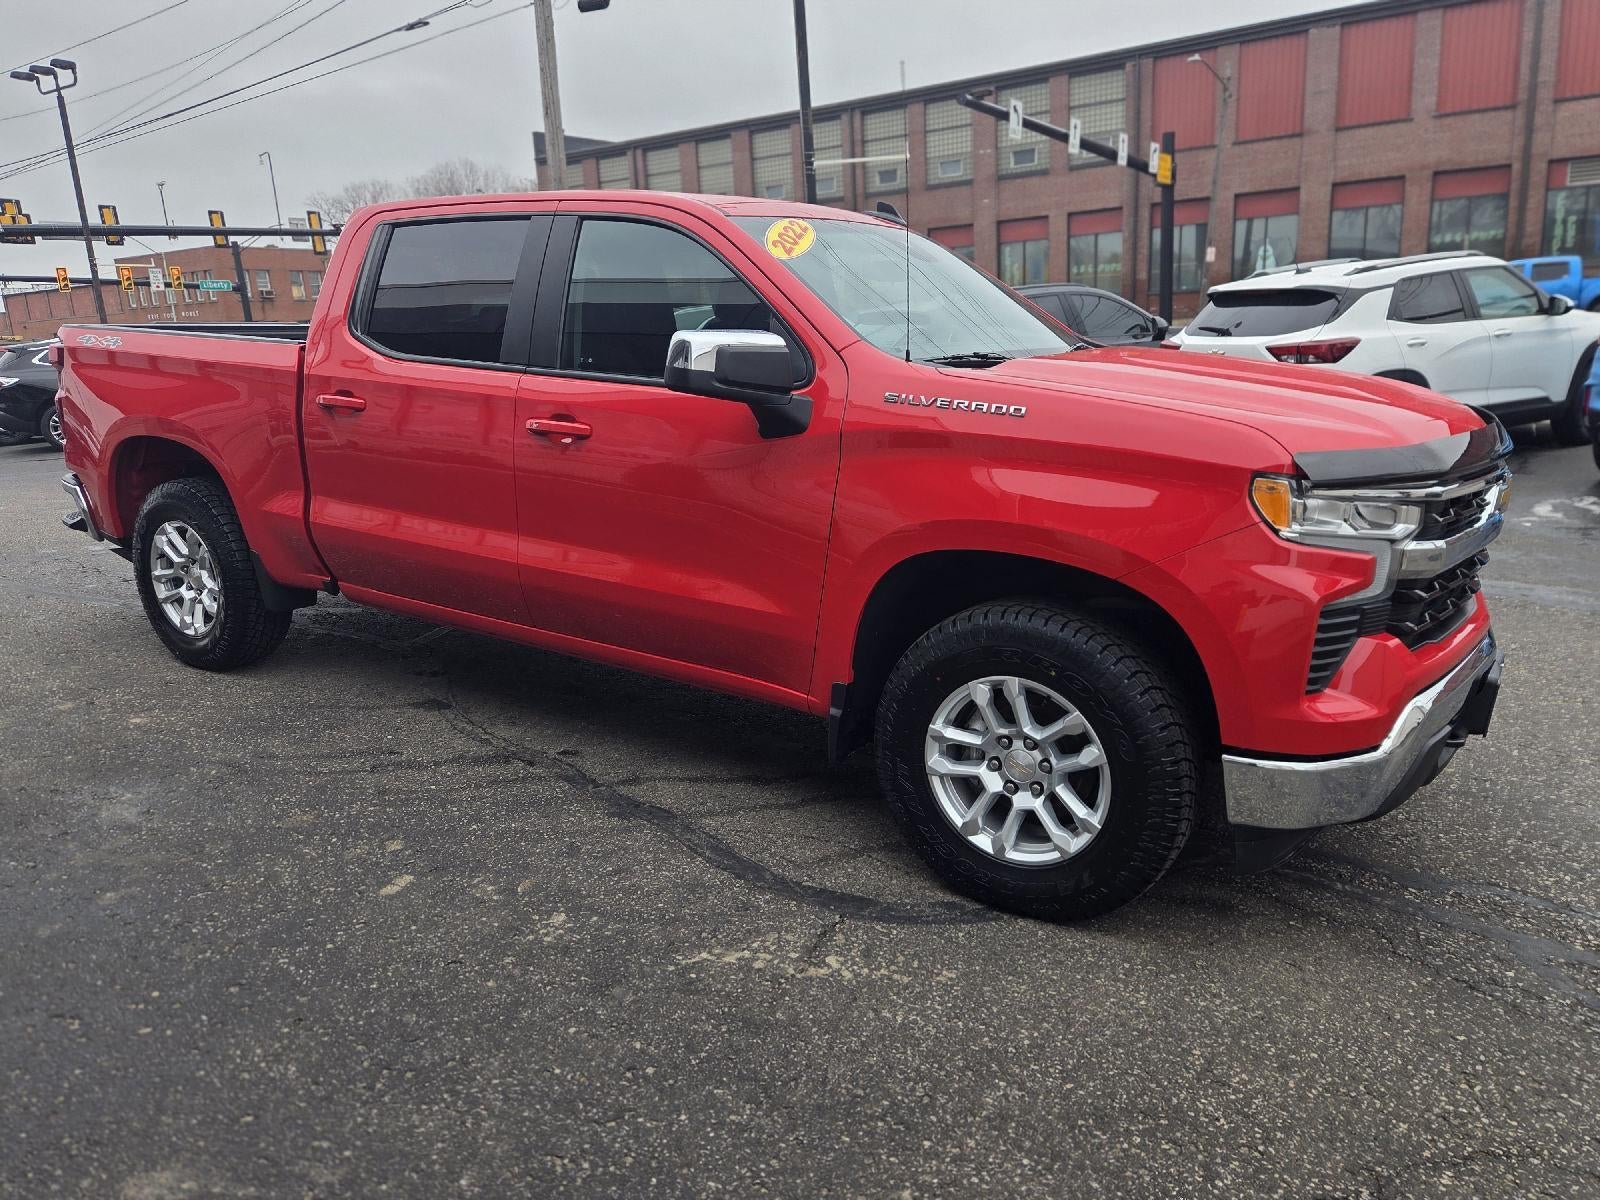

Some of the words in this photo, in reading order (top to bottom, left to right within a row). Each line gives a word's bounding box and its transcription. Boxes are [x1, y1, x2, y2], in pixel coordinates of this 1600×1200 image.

[771, 220, 809, 257] 2022
[202, 281, 228, 289] Liberty
[884, 391, 1028, 418] SILVERADO
